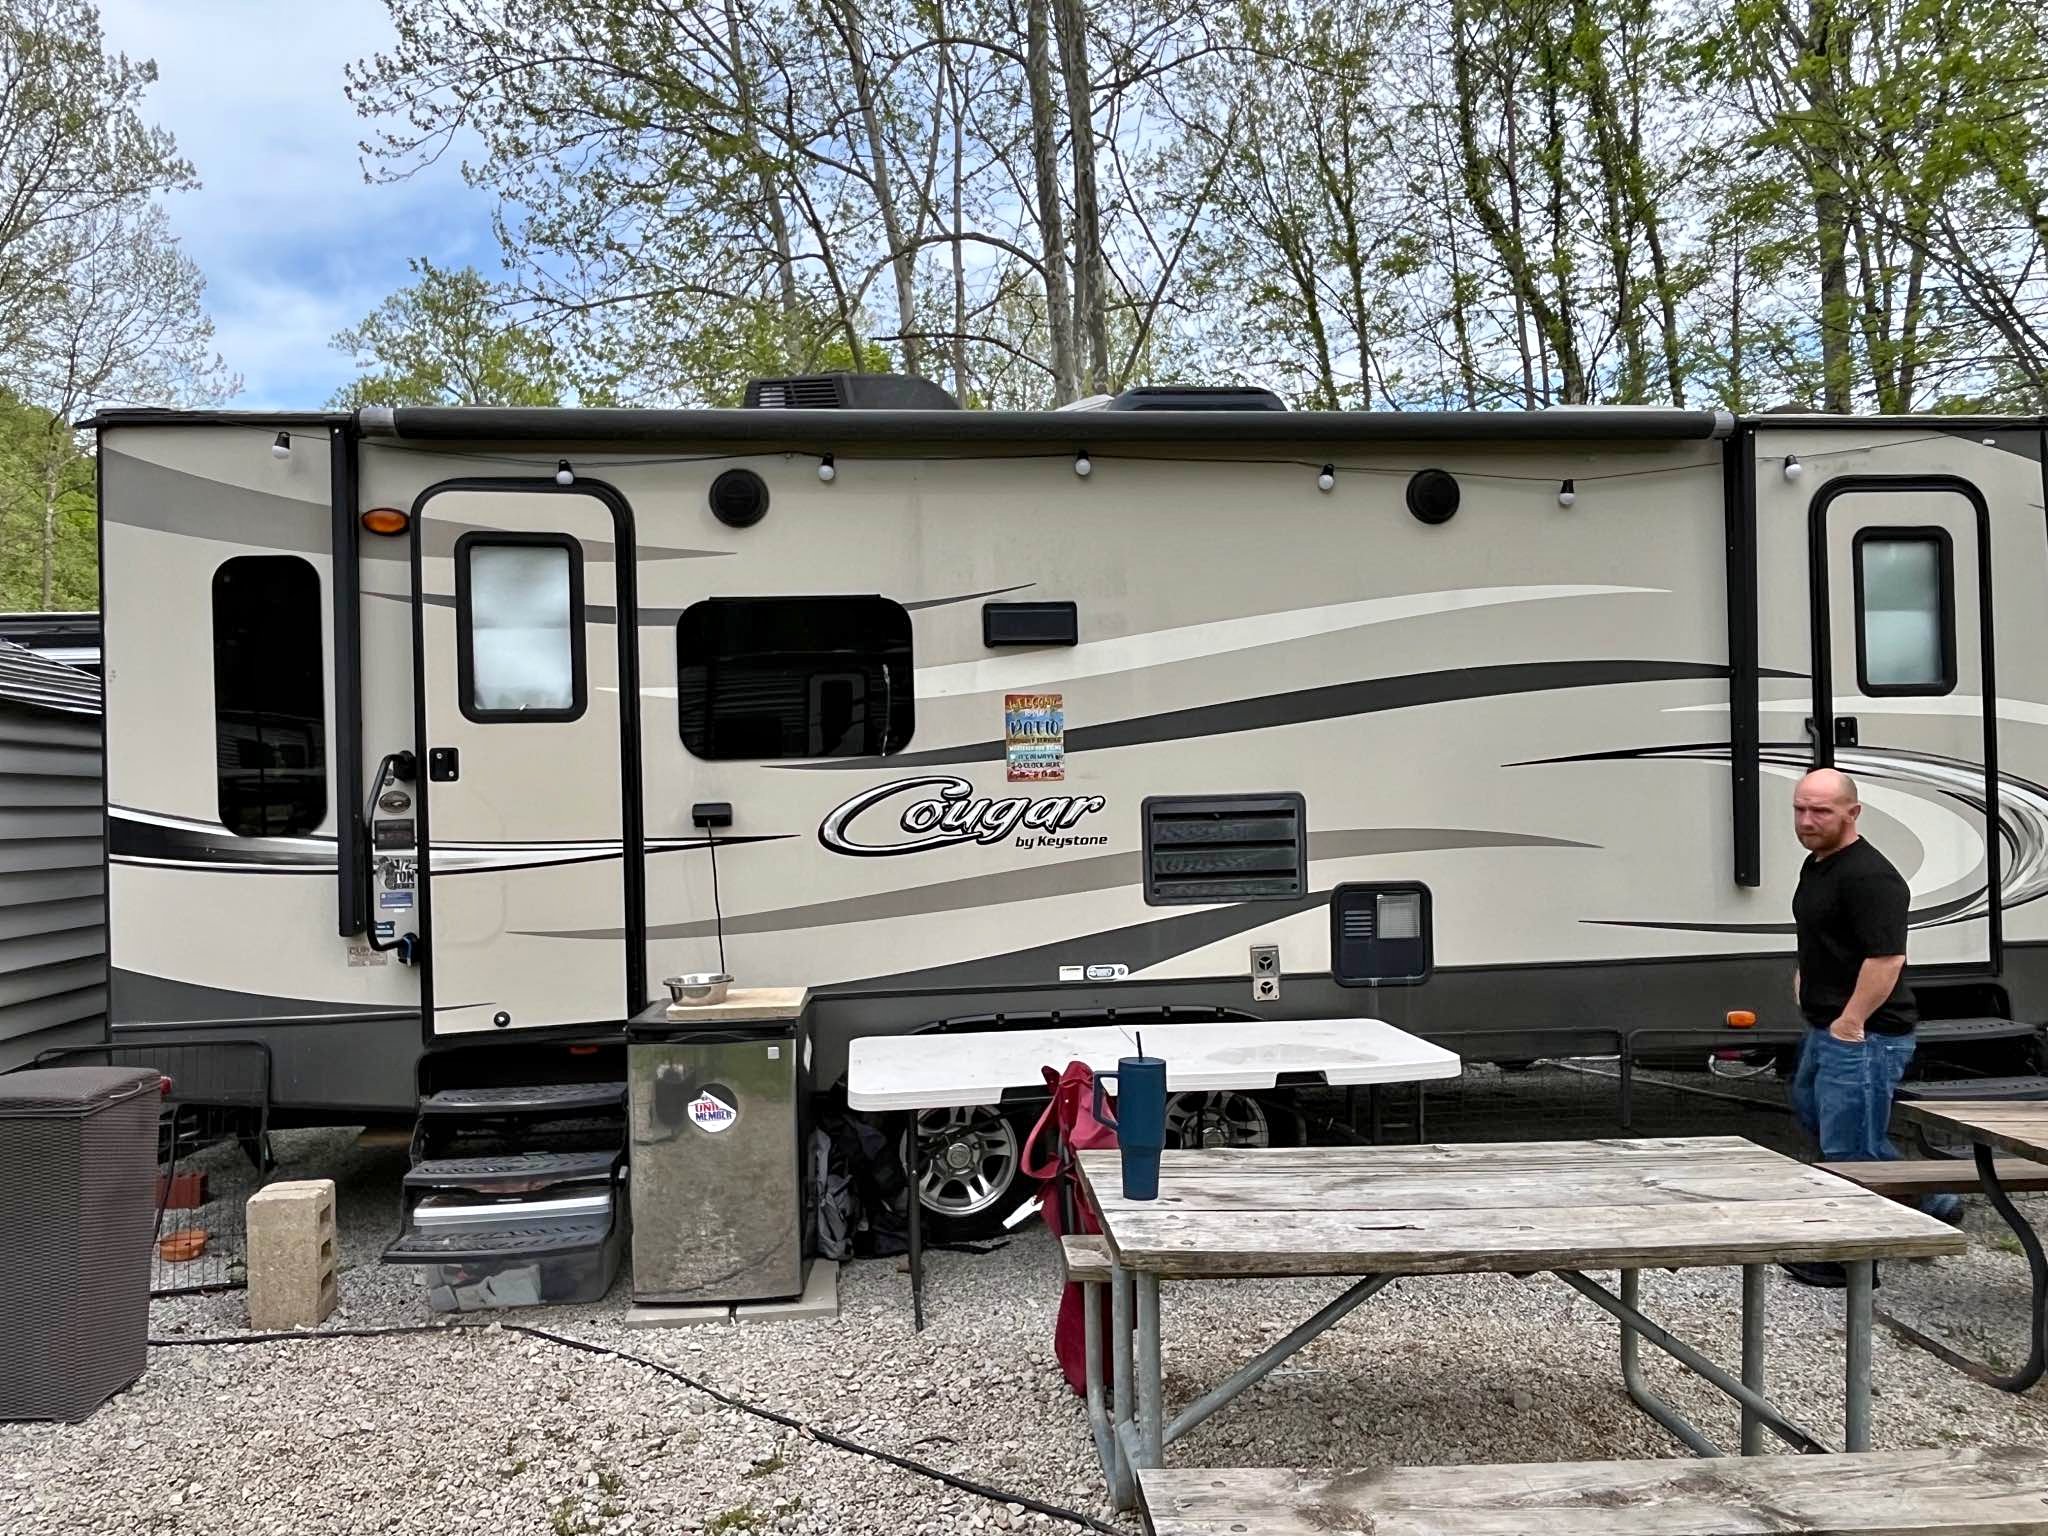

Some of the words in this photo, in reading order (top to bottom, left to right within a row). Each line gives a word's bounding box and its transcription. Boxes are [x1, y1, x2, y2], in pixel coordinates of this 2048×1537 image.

[1010, 719, 1060, 736] PATIO
[818, 775, 1106, 857] Cougar
[1015, 837, 1034, 850] by
[1037, 836, 1108, 849] Keystone
[695, 1110, 732, 1121] MEMBER
